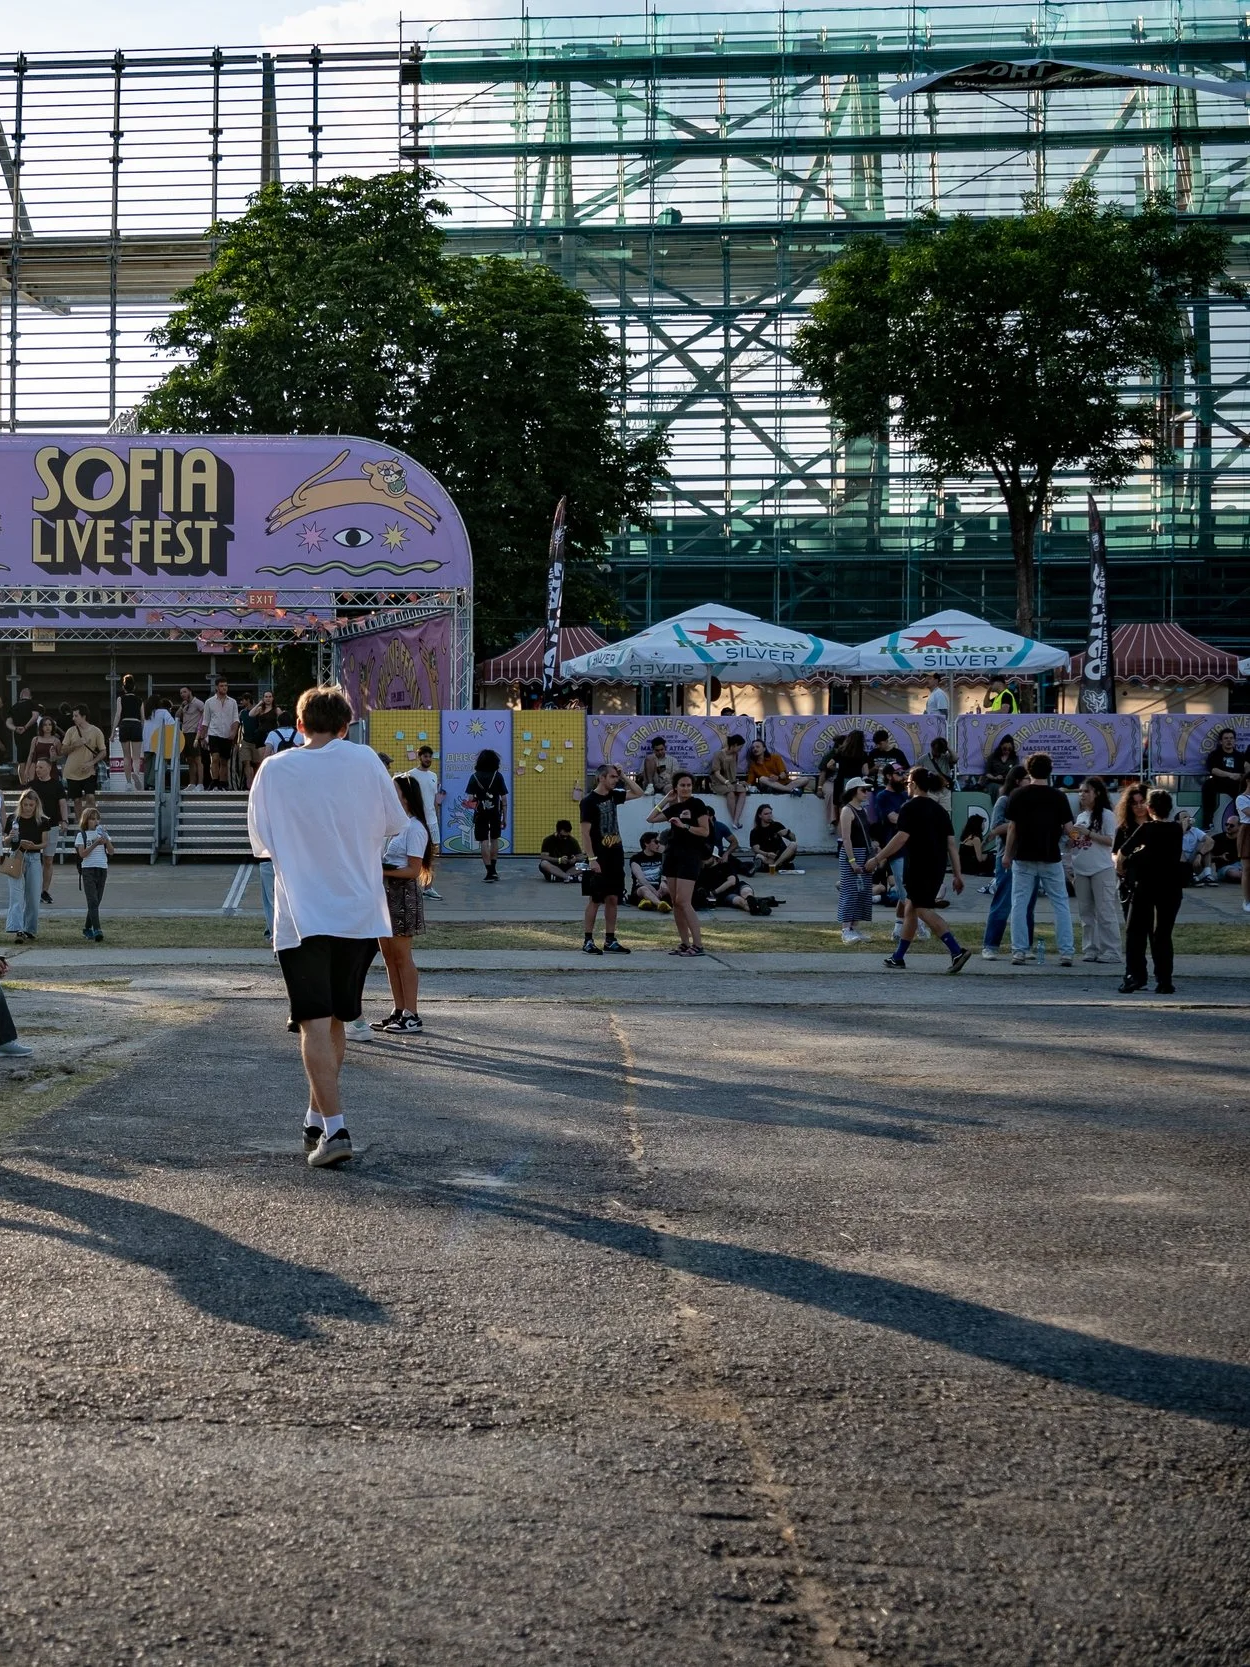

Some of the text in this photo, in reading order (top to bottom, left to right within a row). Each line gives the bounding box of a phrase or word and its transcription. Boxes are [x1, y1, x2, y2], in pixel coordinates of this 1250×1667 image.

[32, 446, 223, 515] SOFIA
[32, 518, 220, 566] LIVE FEST
[249, 595, 274, 604] EXIT
[674, 639, 808, 650] Heineken
[726, 647, 795, 662] SILVER
[878, 644, 1013, 655] Heineken
[924, 654, 998, 667] SILVER
[625, 718, 710, 758] SOFIA LIVE FESTIVAL
[812, 724, 838, 758] SOFIA
[836, 717, 862, 734] LIVE
[1030, 718, 1055, 733] LIVE
[1057, 719, 1095, 758] FESTIVAL
